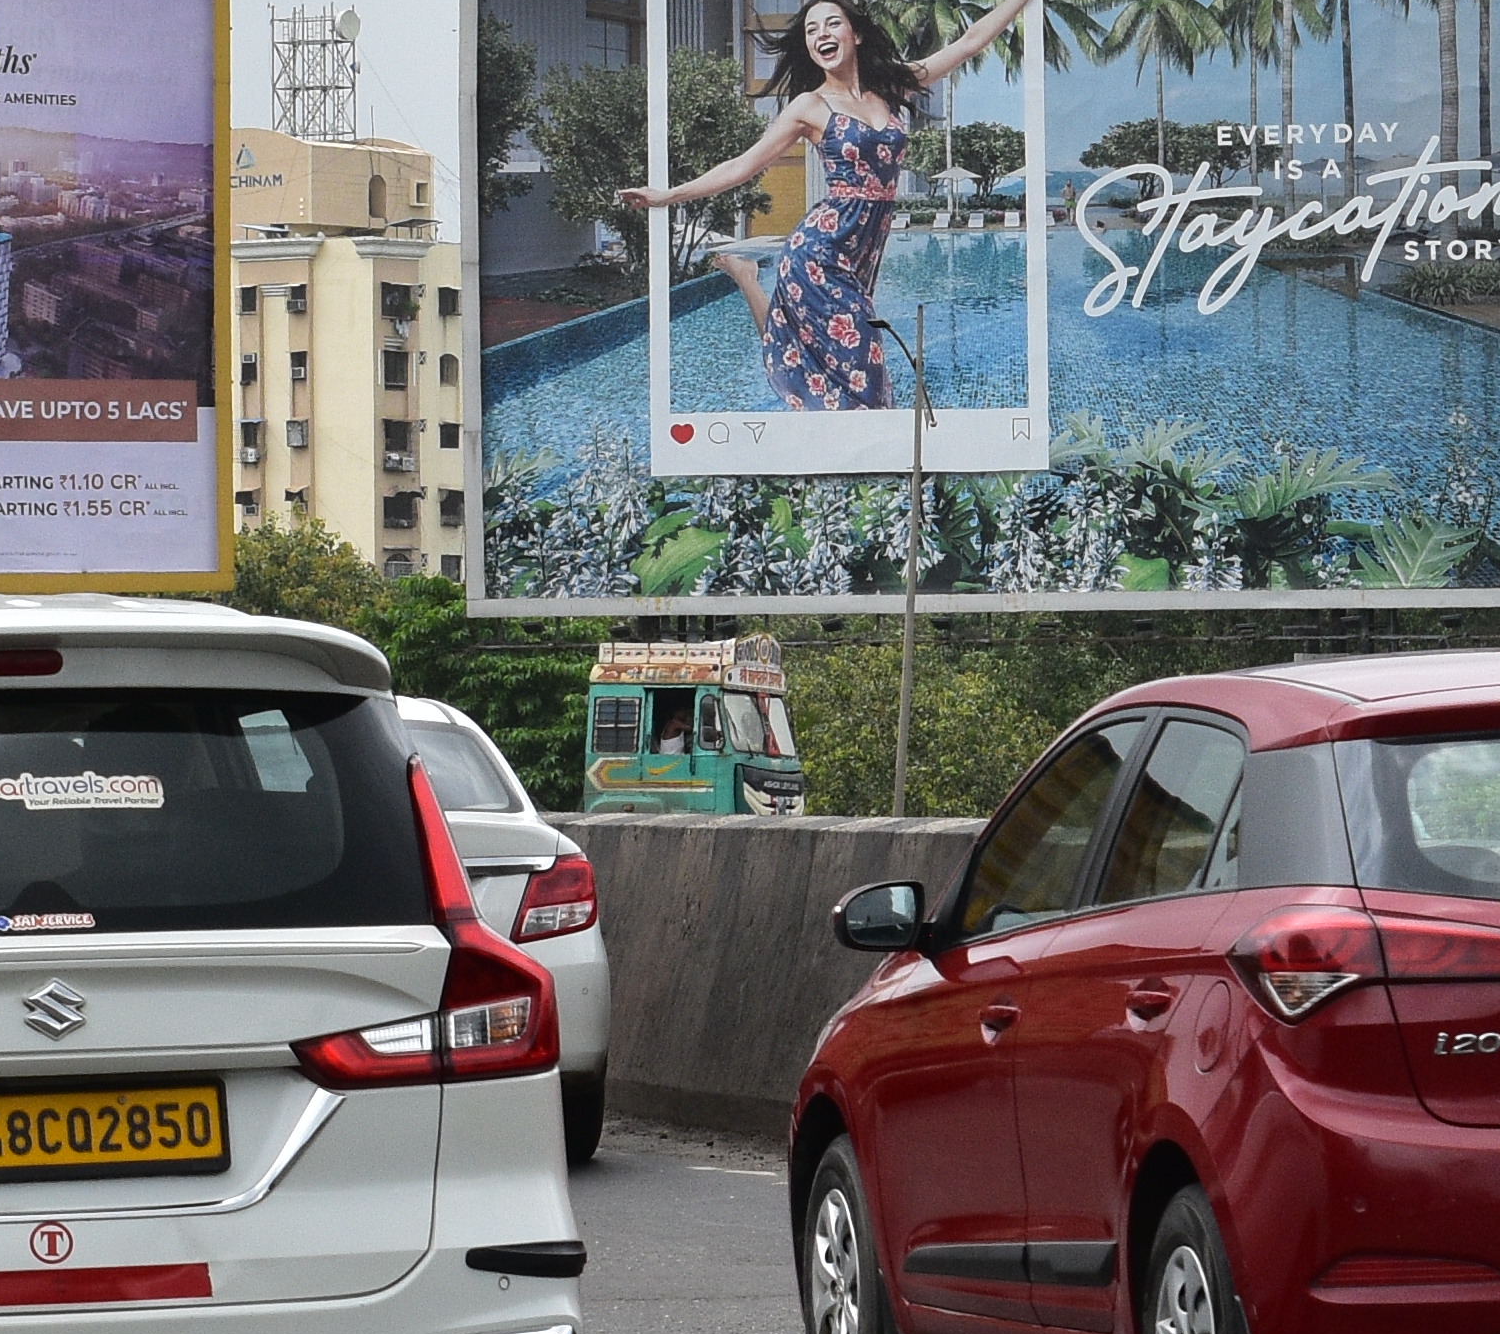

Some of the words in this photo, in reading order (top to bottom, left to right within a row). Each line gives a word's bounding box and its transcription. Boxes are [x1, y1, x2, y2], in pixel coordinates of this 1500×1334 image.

[4, 91, 77, 107] AMENITIES
[1217, 122, 1399, 146] EVERYDAY
[1274, 159, 1303, 180] IS
[1321, 158, 1341, 179] A
[39, 400, 101, 421] UPTO
[106, 400, 120, 421] 5
[58, 472, 104, 492] ₹1.10
[62, 499, 113, 517] ₹1.55
[28, 798, 50, 807] Your
[52, 797, 92, 806] Reliable
[94, 797, 123, 805] Travel
[124, 797, 160, 805] Partner
[41, 914, 92, 926] SERVICE
